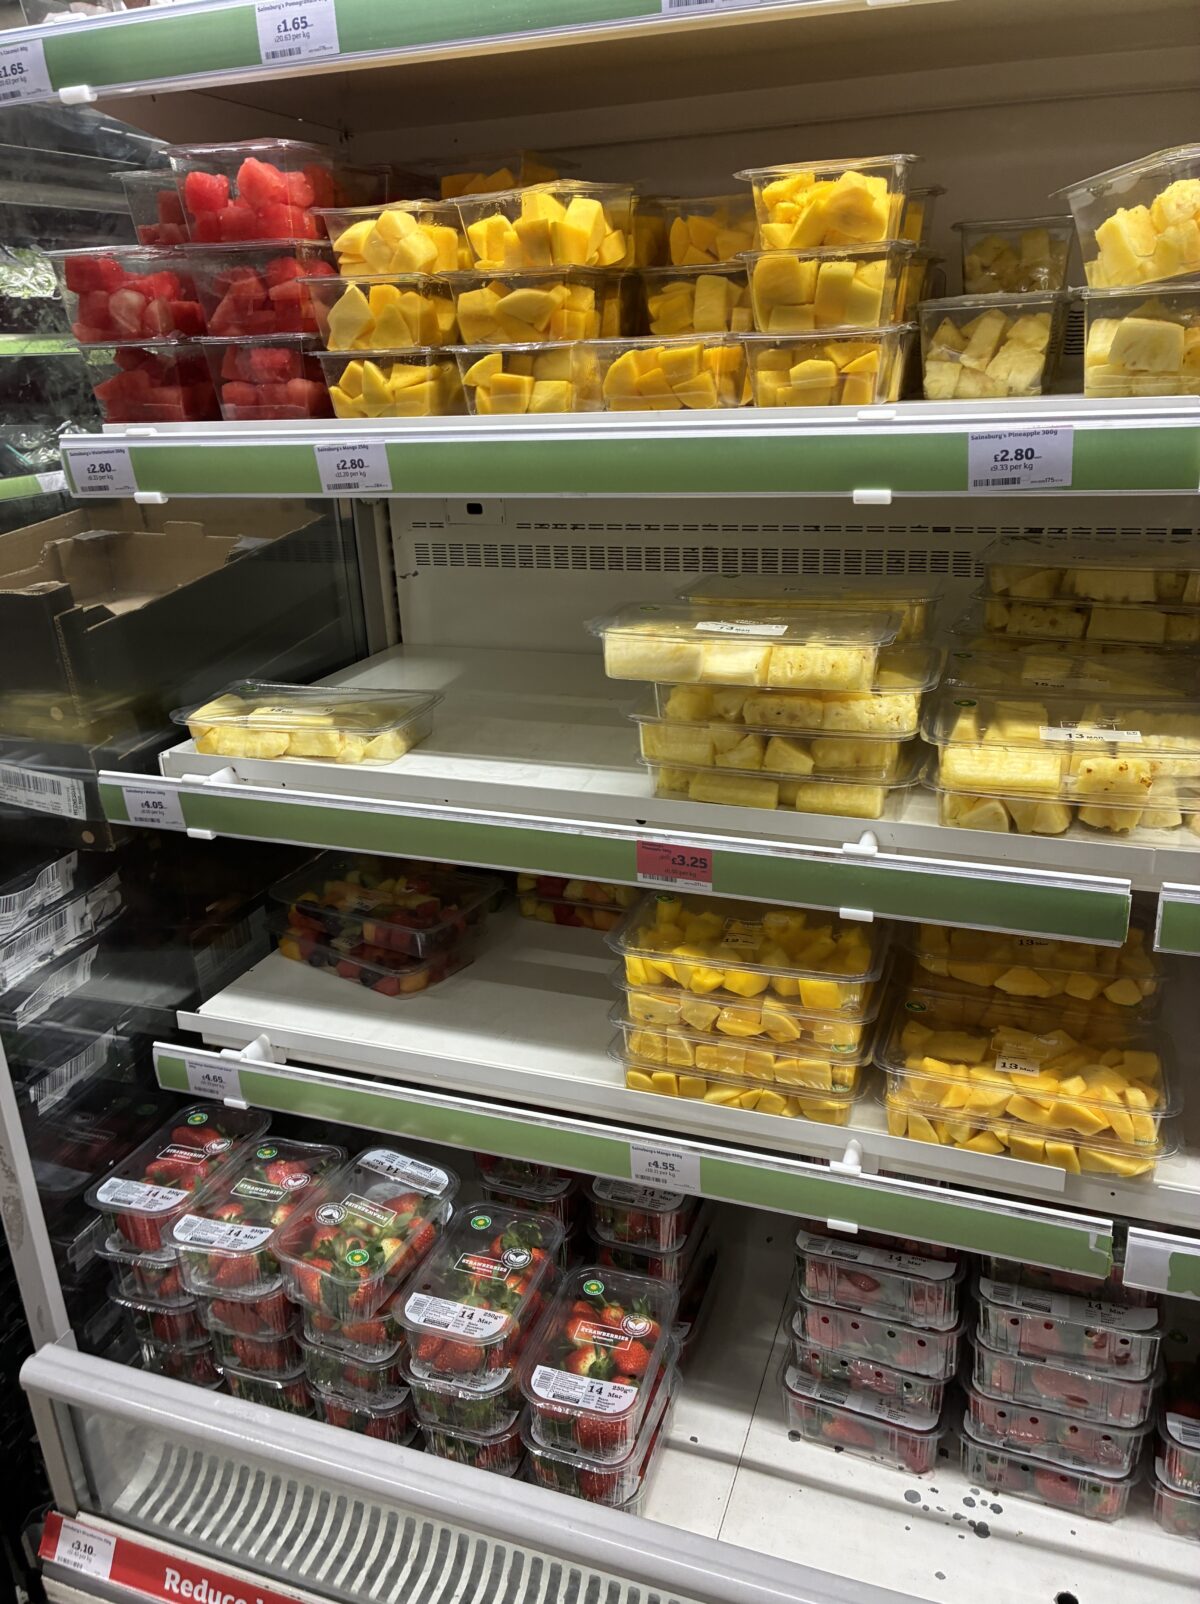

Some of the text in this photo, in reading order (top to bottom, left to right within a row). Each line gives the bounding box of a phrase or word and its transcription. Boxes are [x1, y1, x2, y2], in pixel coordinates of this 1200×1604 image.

[277, 16, 308, 33] £1.65
[1008, 430, 1040, 438] Pineapple
[994, 448, 1035, 462] £2.80
[87, 462, 112, 473] £2.80
[336, 458, 364, 470] £2.80
[1009, 464, 1022, 472] per
[1023, 462, 1033, 470] kg
[141, 800, 163, 809] £4.05
[671, 855, 708, 869] £3.25
[1001, 1061, 1019, 1070] 13
[202, 1073, 223, 1083] £4.65
[385, 1165, 400, 1174] 14
[648, 1160, 676, 1171] £4.55
[144, 1189, 160, 1198] 14
[239, 1183, 284, 1196] STRAWBERRIES
[642, 1189, 655, 1197] 14
[226, 1229, 242, 1238] 14
[888, 1253, 902, 1262] 14
[462, 1258, 508, 1273] STRAWBERRIES
[1087, 1301, 1102, 1311] 14
[459, 1310, 499, 1320] 14 250g
[478, 1317, 492, 1325] Mar
[580, 1326, 629, 1341] STRAWBERRIES
[588, 1385, 628, 1395] 14 250g
[607, 1392, 622, 1400] Mar
[72, 1540, 94, 1555] £3.10
